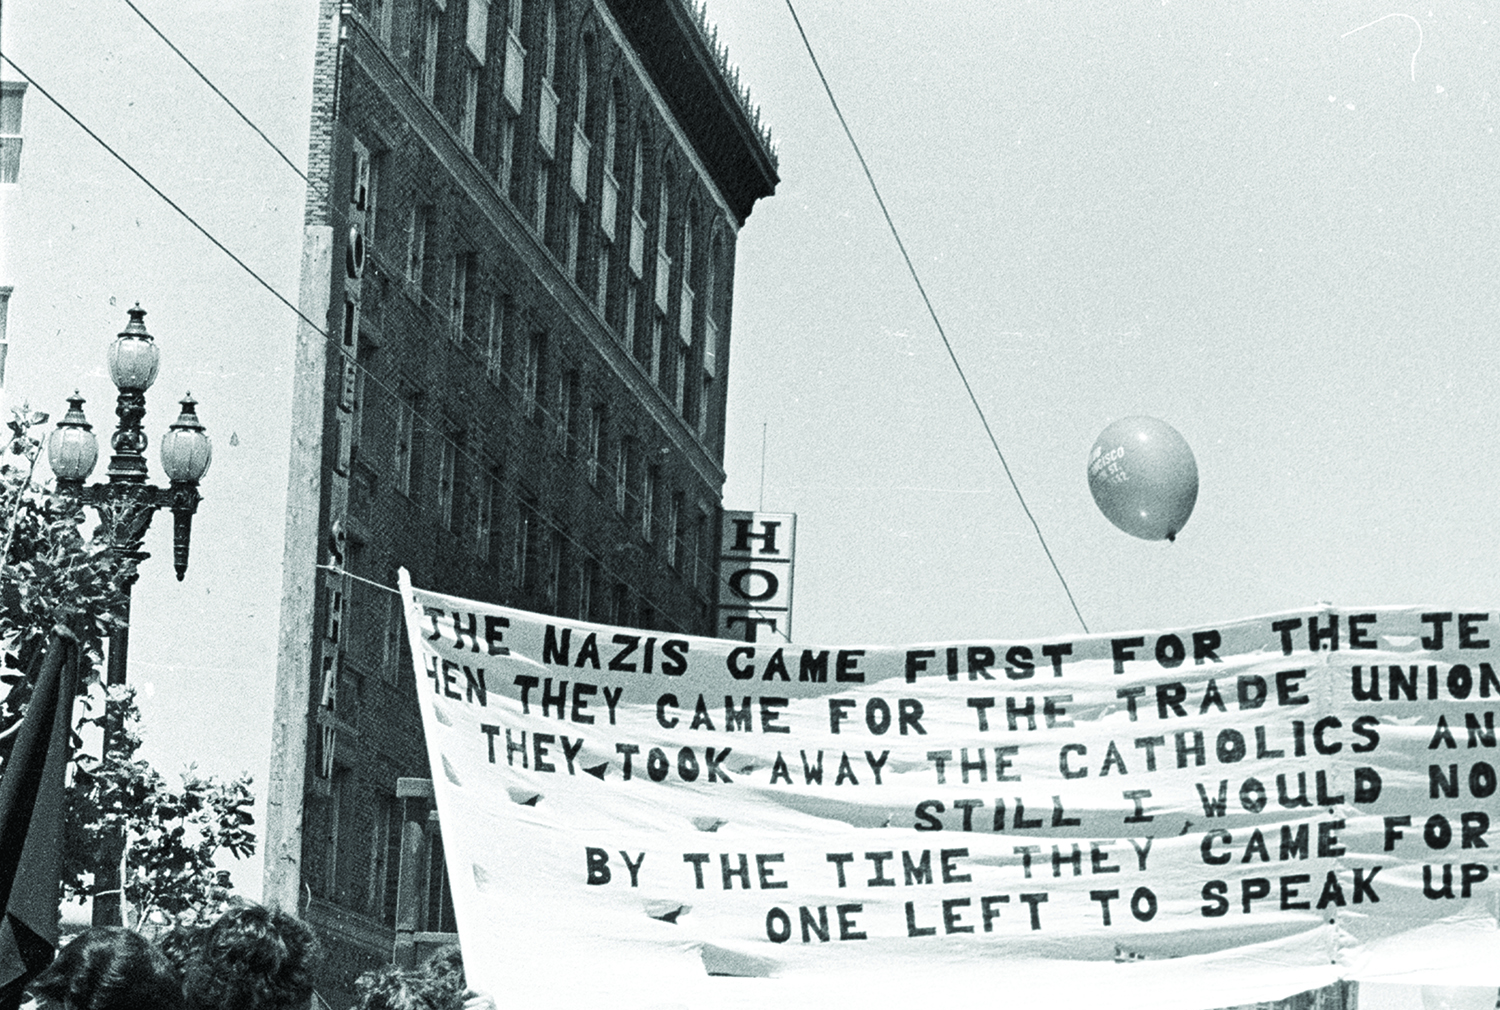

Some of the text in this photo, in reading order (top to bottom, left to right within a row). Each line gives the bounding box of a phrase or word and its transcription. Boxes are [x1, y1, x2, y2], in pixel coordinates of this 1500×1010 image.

[422, 605, 511, 656] THE
[542, 625, 689, 676] NAZIS
[726, 646, 865, 683] CAME
[905, 643, 1073, 684] FIRST
[1111, 629, 1223, 675] FOR
[1272, 613, 1378, 656] THE
[514, 674, 623, 725] THEY
[655, 693, 791, 734] CAME
[829, 697, 928, 736] FOR
[967, 694, 1074, 732] THE
[1116, 669, 1311, 722] TRADE
[480, 723, 584, 775] THEY
[615, 743, 733, 783] TOOK
[769, 750, 890, 786] AWAY
[927, 745, 1022, 785] THE
[1058, 716, 1381, 781] CATHOLICS
[913, 795, 1082, 833] STILL
[1122, 788, 1155, 825] I
[1195, 767, 1382, 818] WOULD
[584, 845, 646, 889] BY
[683, 851, 789, 891] THE
[825, 847, 972, 889] TIME
[1013, 835, 1155, 879] THEY
[1199, 818, 1347, 866] CAME
[1382, 810, 1490, 852] FOR
[765, 903, 867, 943] ONE
[905, 892, 1049, 937] LEFT
[1089, 885, 1158, 926] TO
[1200, 865, 1383, 919] SPEAK
[1421, 862, 1490, 899] UP
